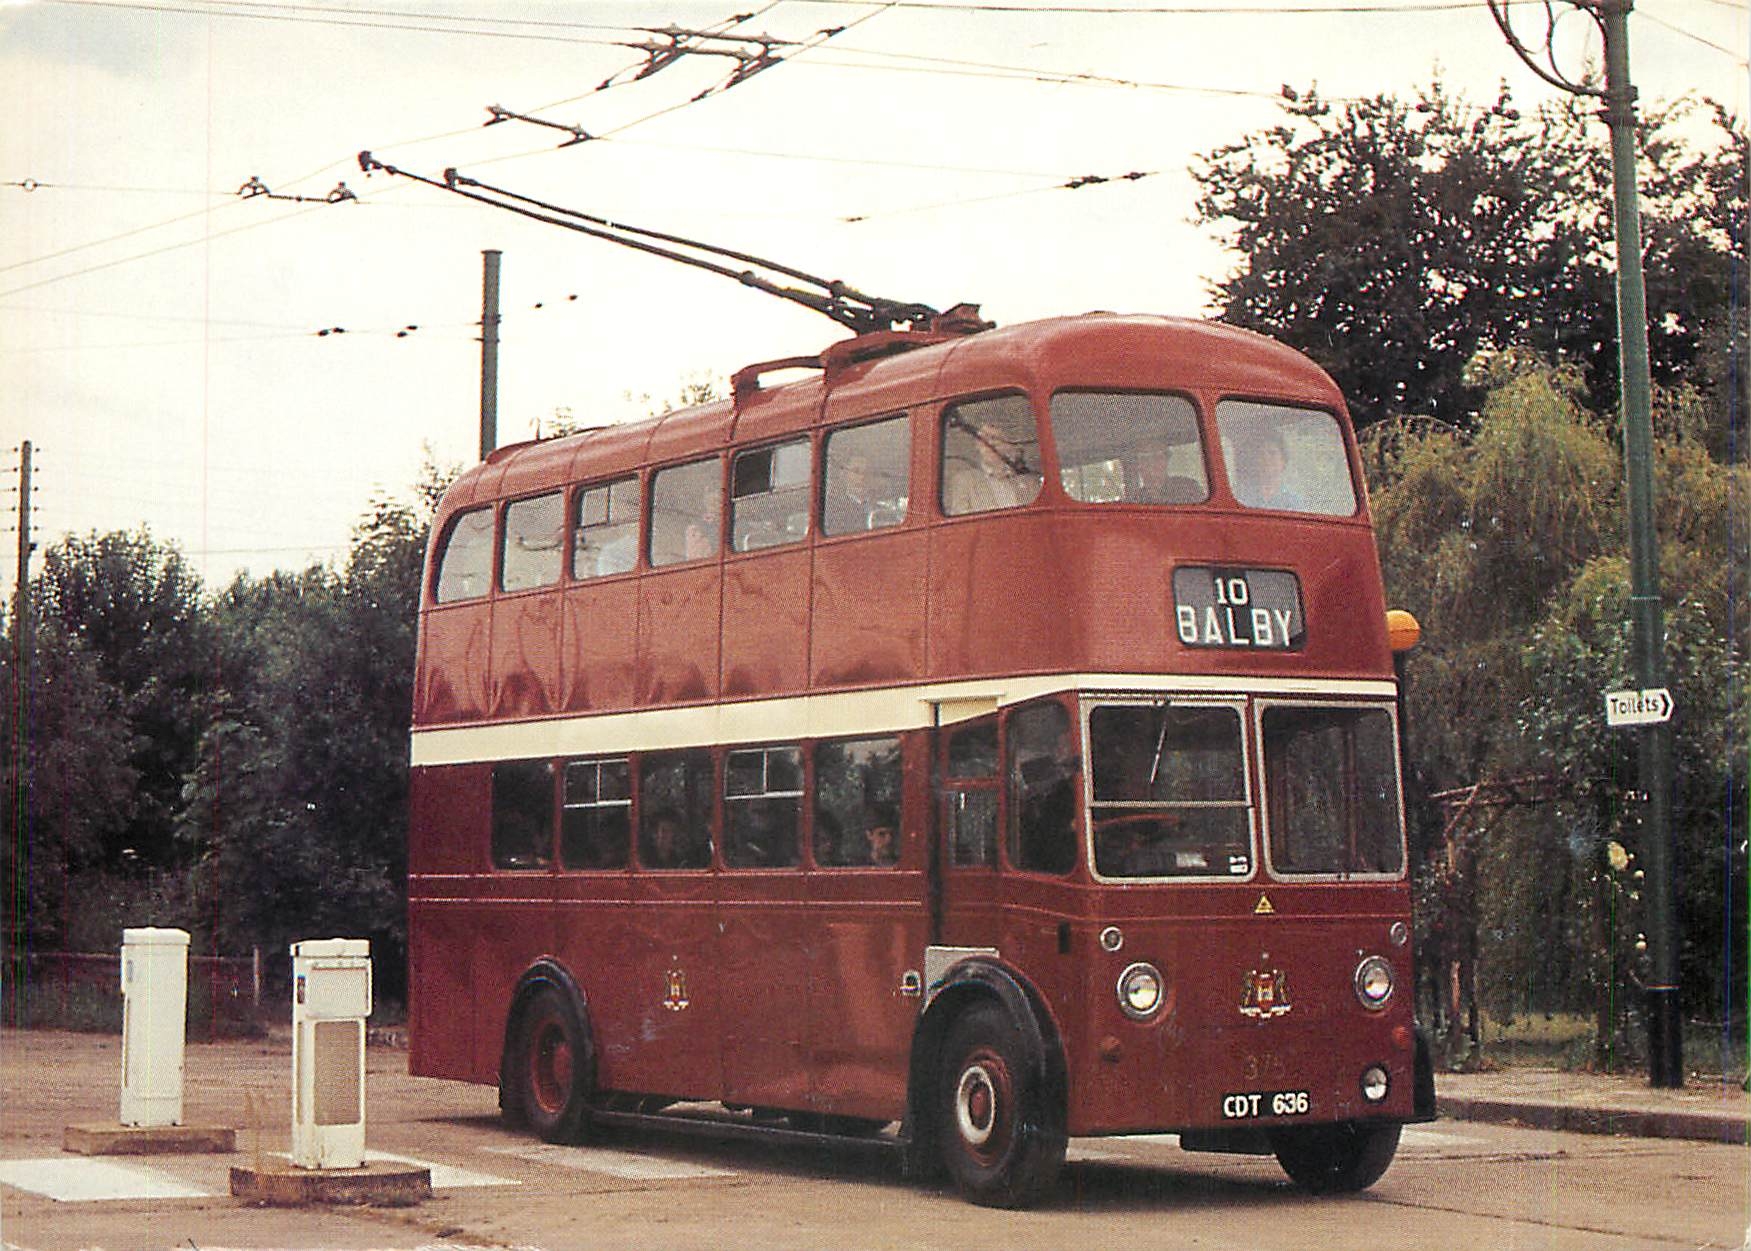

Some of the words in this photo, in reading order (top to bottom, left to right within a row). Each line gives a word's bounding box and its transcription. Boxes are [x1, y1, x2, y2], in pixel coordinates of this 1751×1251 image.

[1215, 577, 1248, 605] 10
[1176, 605, 1292, 647] BALBY
[1610, 696, 1658, 714] Toilets
[1223, 1094, 1262, 1118] CDT
[1272, 1092, 1309, 1115] 636
